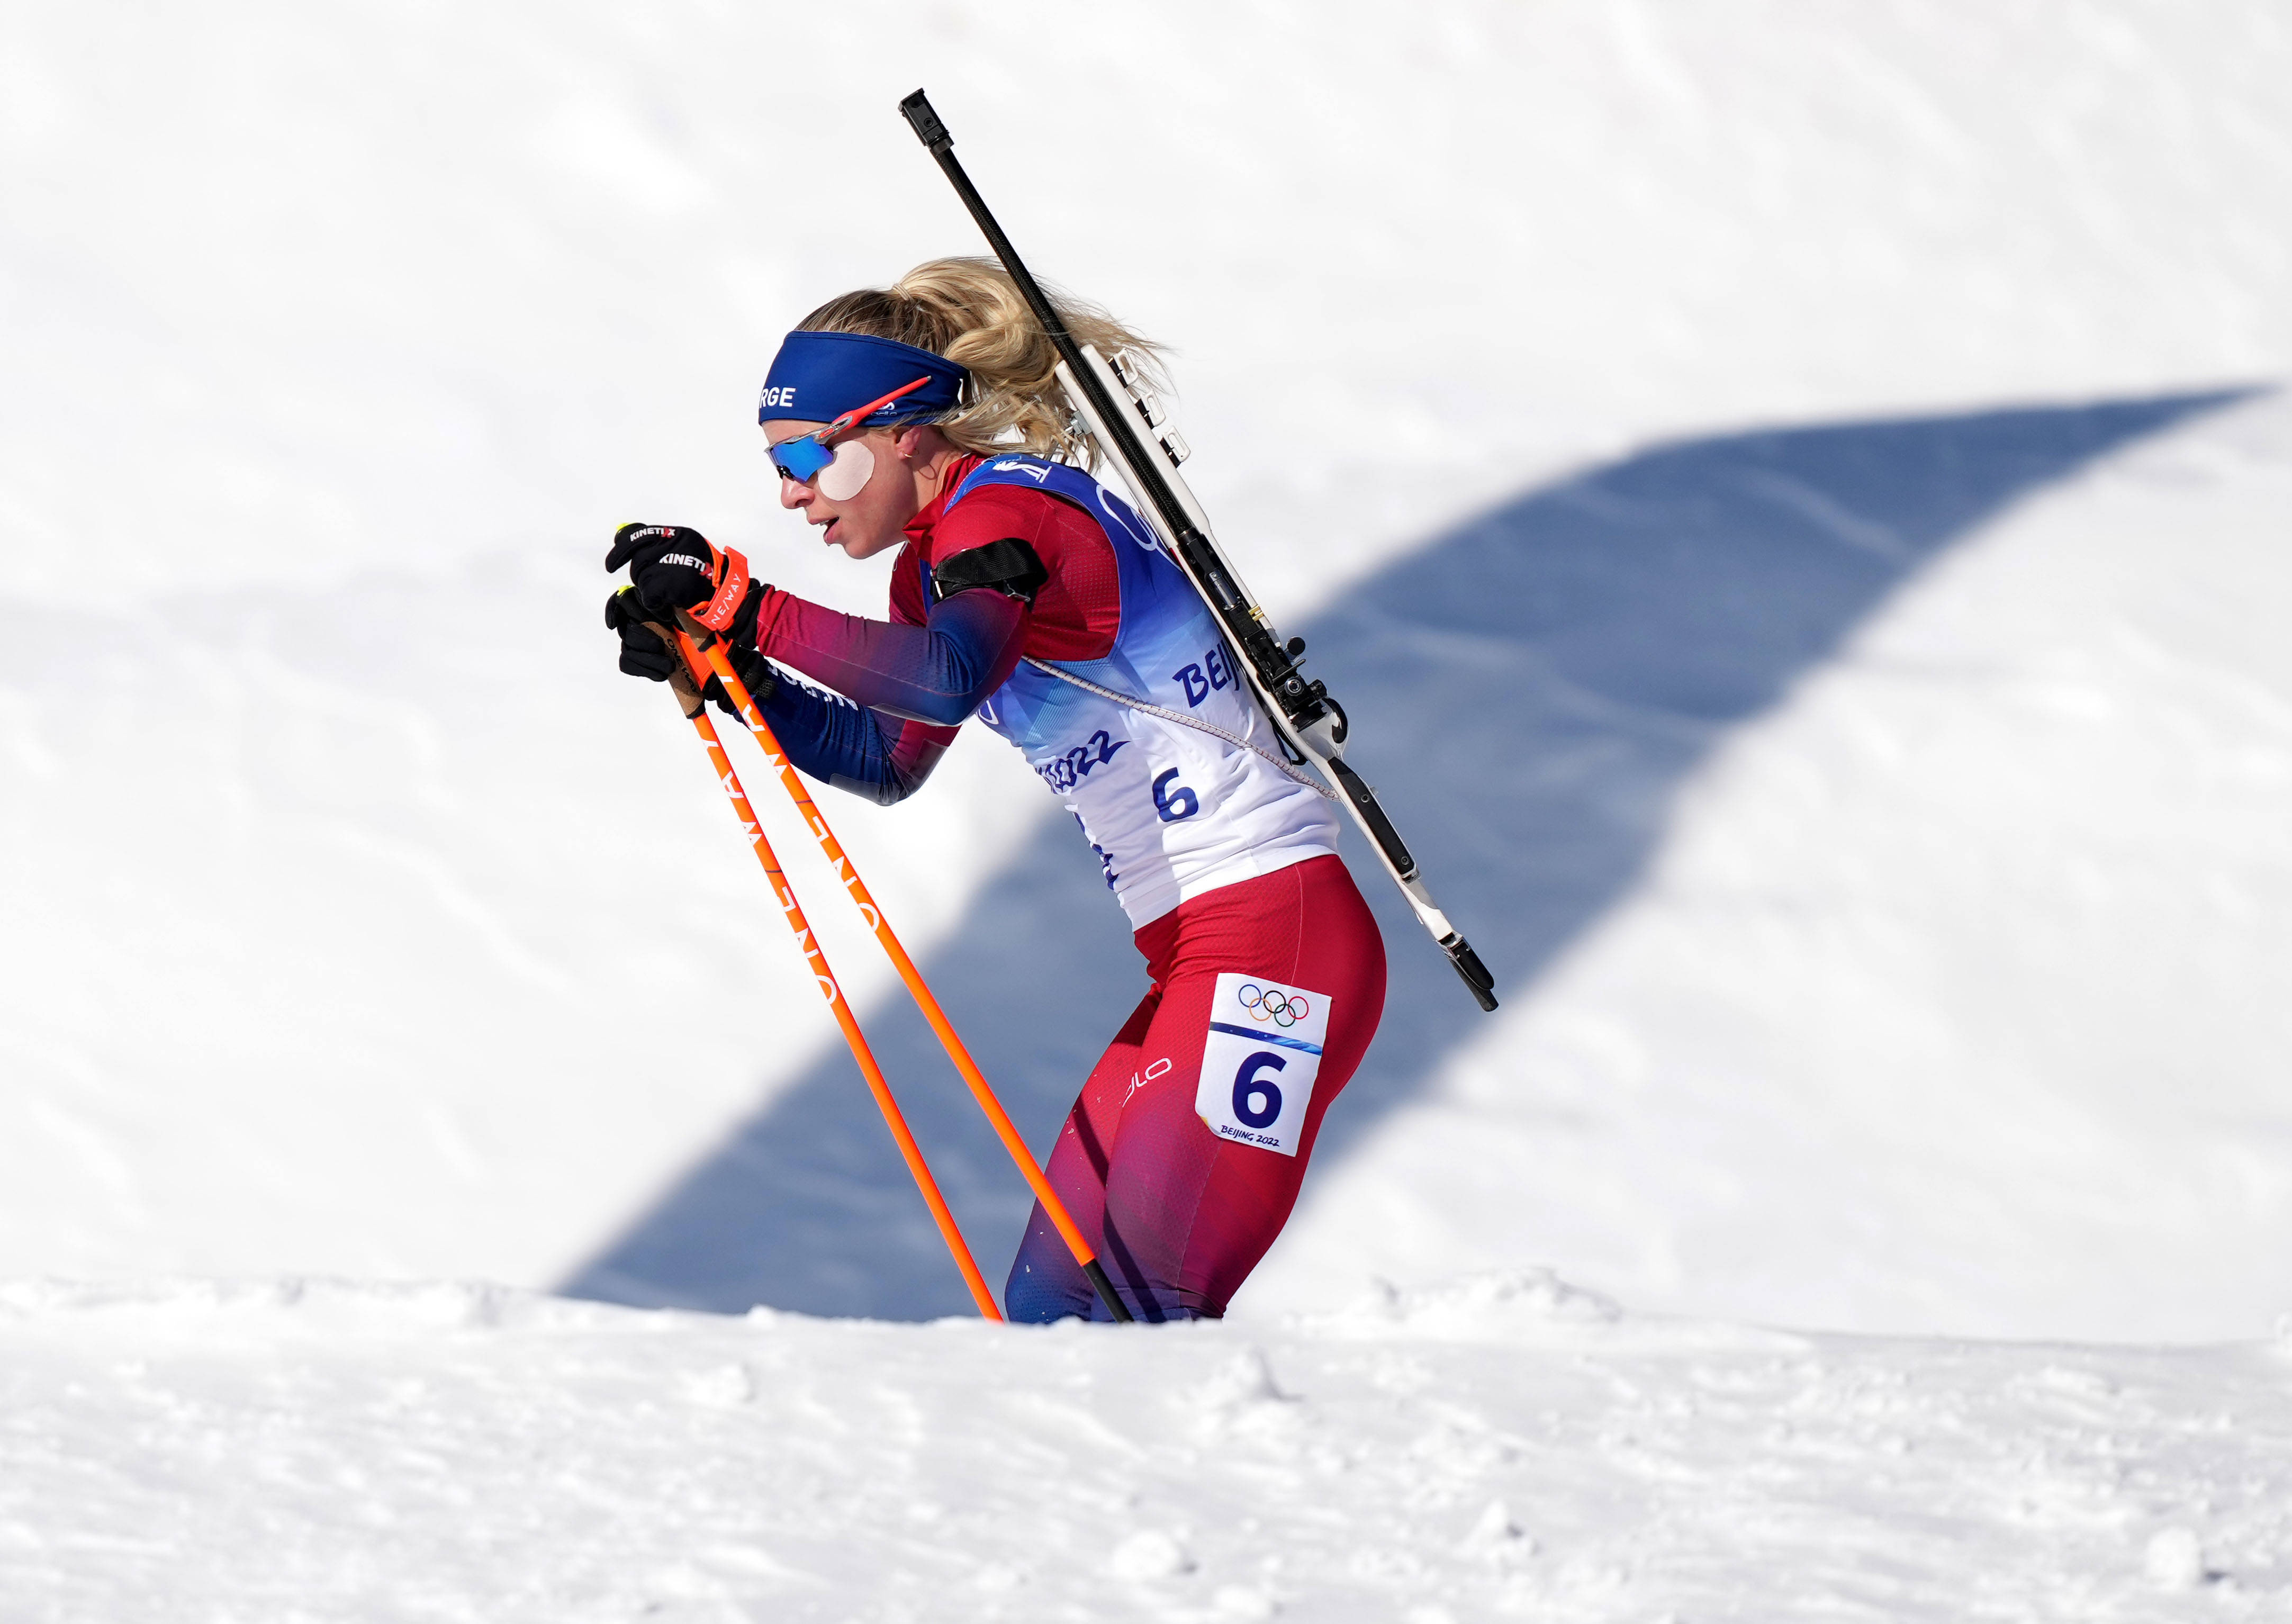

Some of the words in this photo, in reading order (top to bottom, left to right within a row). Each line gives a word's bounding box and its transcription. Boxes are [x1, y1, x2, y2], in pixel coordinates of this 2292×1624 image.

[710, 573, 741, 624] NE/WAY
[1152, 767, 1199, 822] 6
[1232, 1051, 1287, 1129] 6
[1221, 1125, 1255, 1141] BEIJING
[1256, 1135, 1280, 1147] 2022
